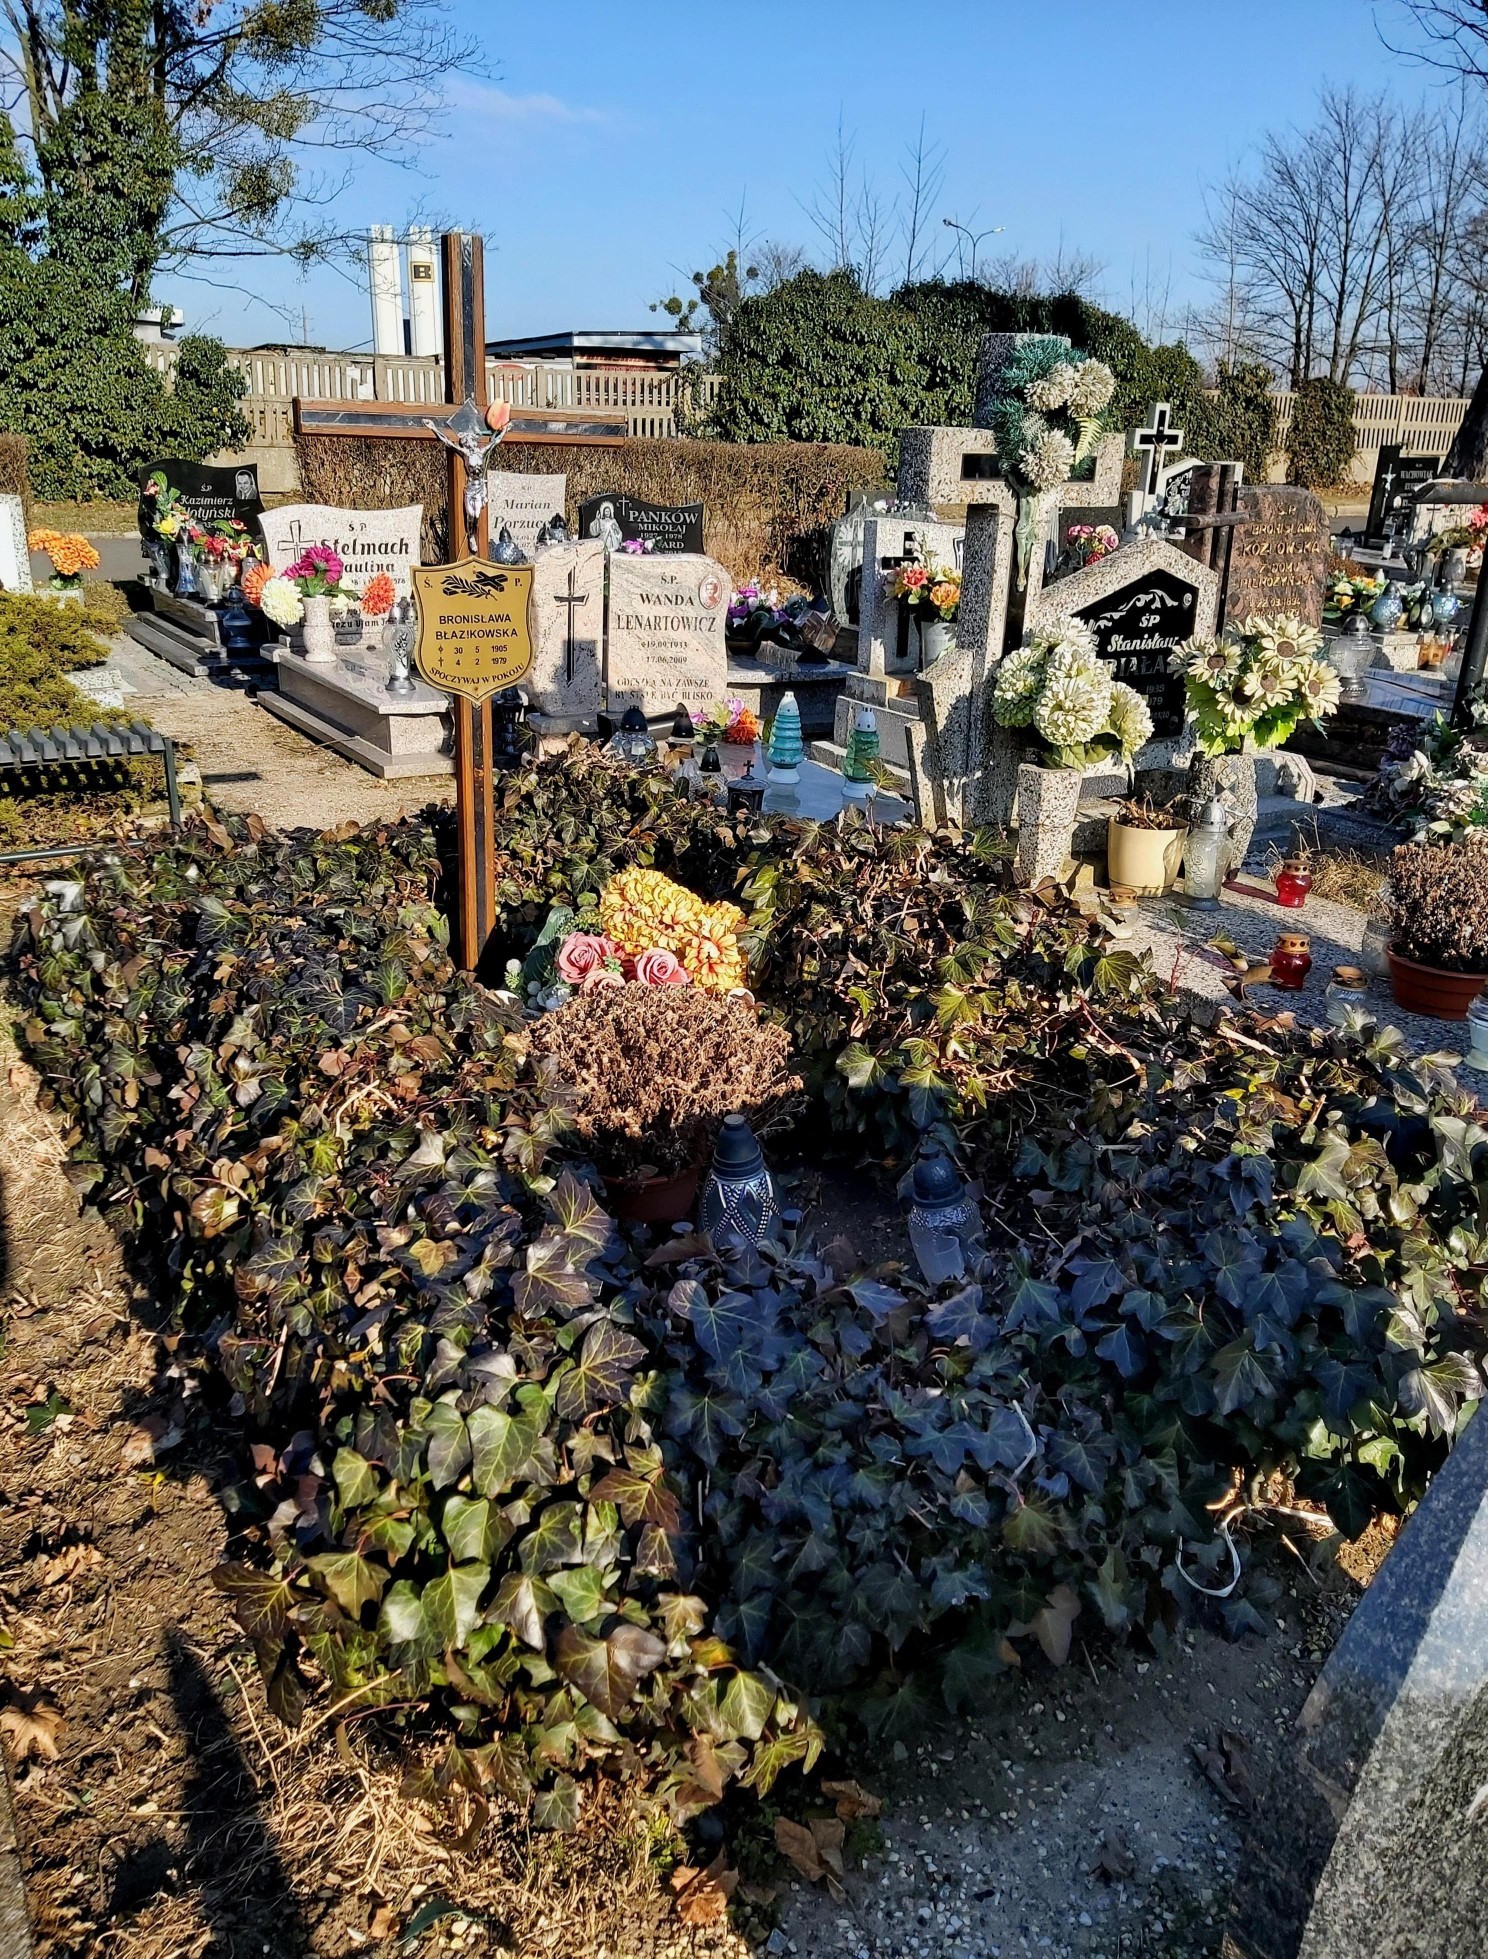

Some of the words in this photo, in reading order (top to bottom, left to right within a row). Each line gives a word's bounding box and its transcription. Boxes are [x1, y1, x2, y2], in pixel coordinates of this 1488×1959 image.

[180, 494, 234, 505] Kazimierz
[503, 499, 551, 510] Marian
[629, 509, 699, 525] PANKÓW
[638, 523, 686, 535] MIKOŁAJ
[321, 538, 410, 556] Stelmach
[344, 559, 396, 574] aulina
[424, 576, 433, 588] Ś.
[514, 577, 523, 587] P.
[639, 593, 695, 606] WANDA
[439, 613, 512, 625] BRONISŁAWA
[617, 614, 717, 632] LENARTOWICZ
[1139, 613, 1161, 628] ŚP
[1107, 632, 1179, 652] Stanisław
[454, 646, 463, 655] 30
[475, 646, 480, 654] 5
[491, 644, 508, 653] 1905
[455, 658, 461, 666] 4
[475, 658, 480, 666] 2
[491, 657, 507, 665] 1979
[429, 666, 480, 685] SPOCZYWAJ
[481, 676, 490, 684] W
[492, 662, 525, 682] POKOJU
[676, 678, 710, 688] ZAWSZE
[682, 691, 713, 701] BLISKO
